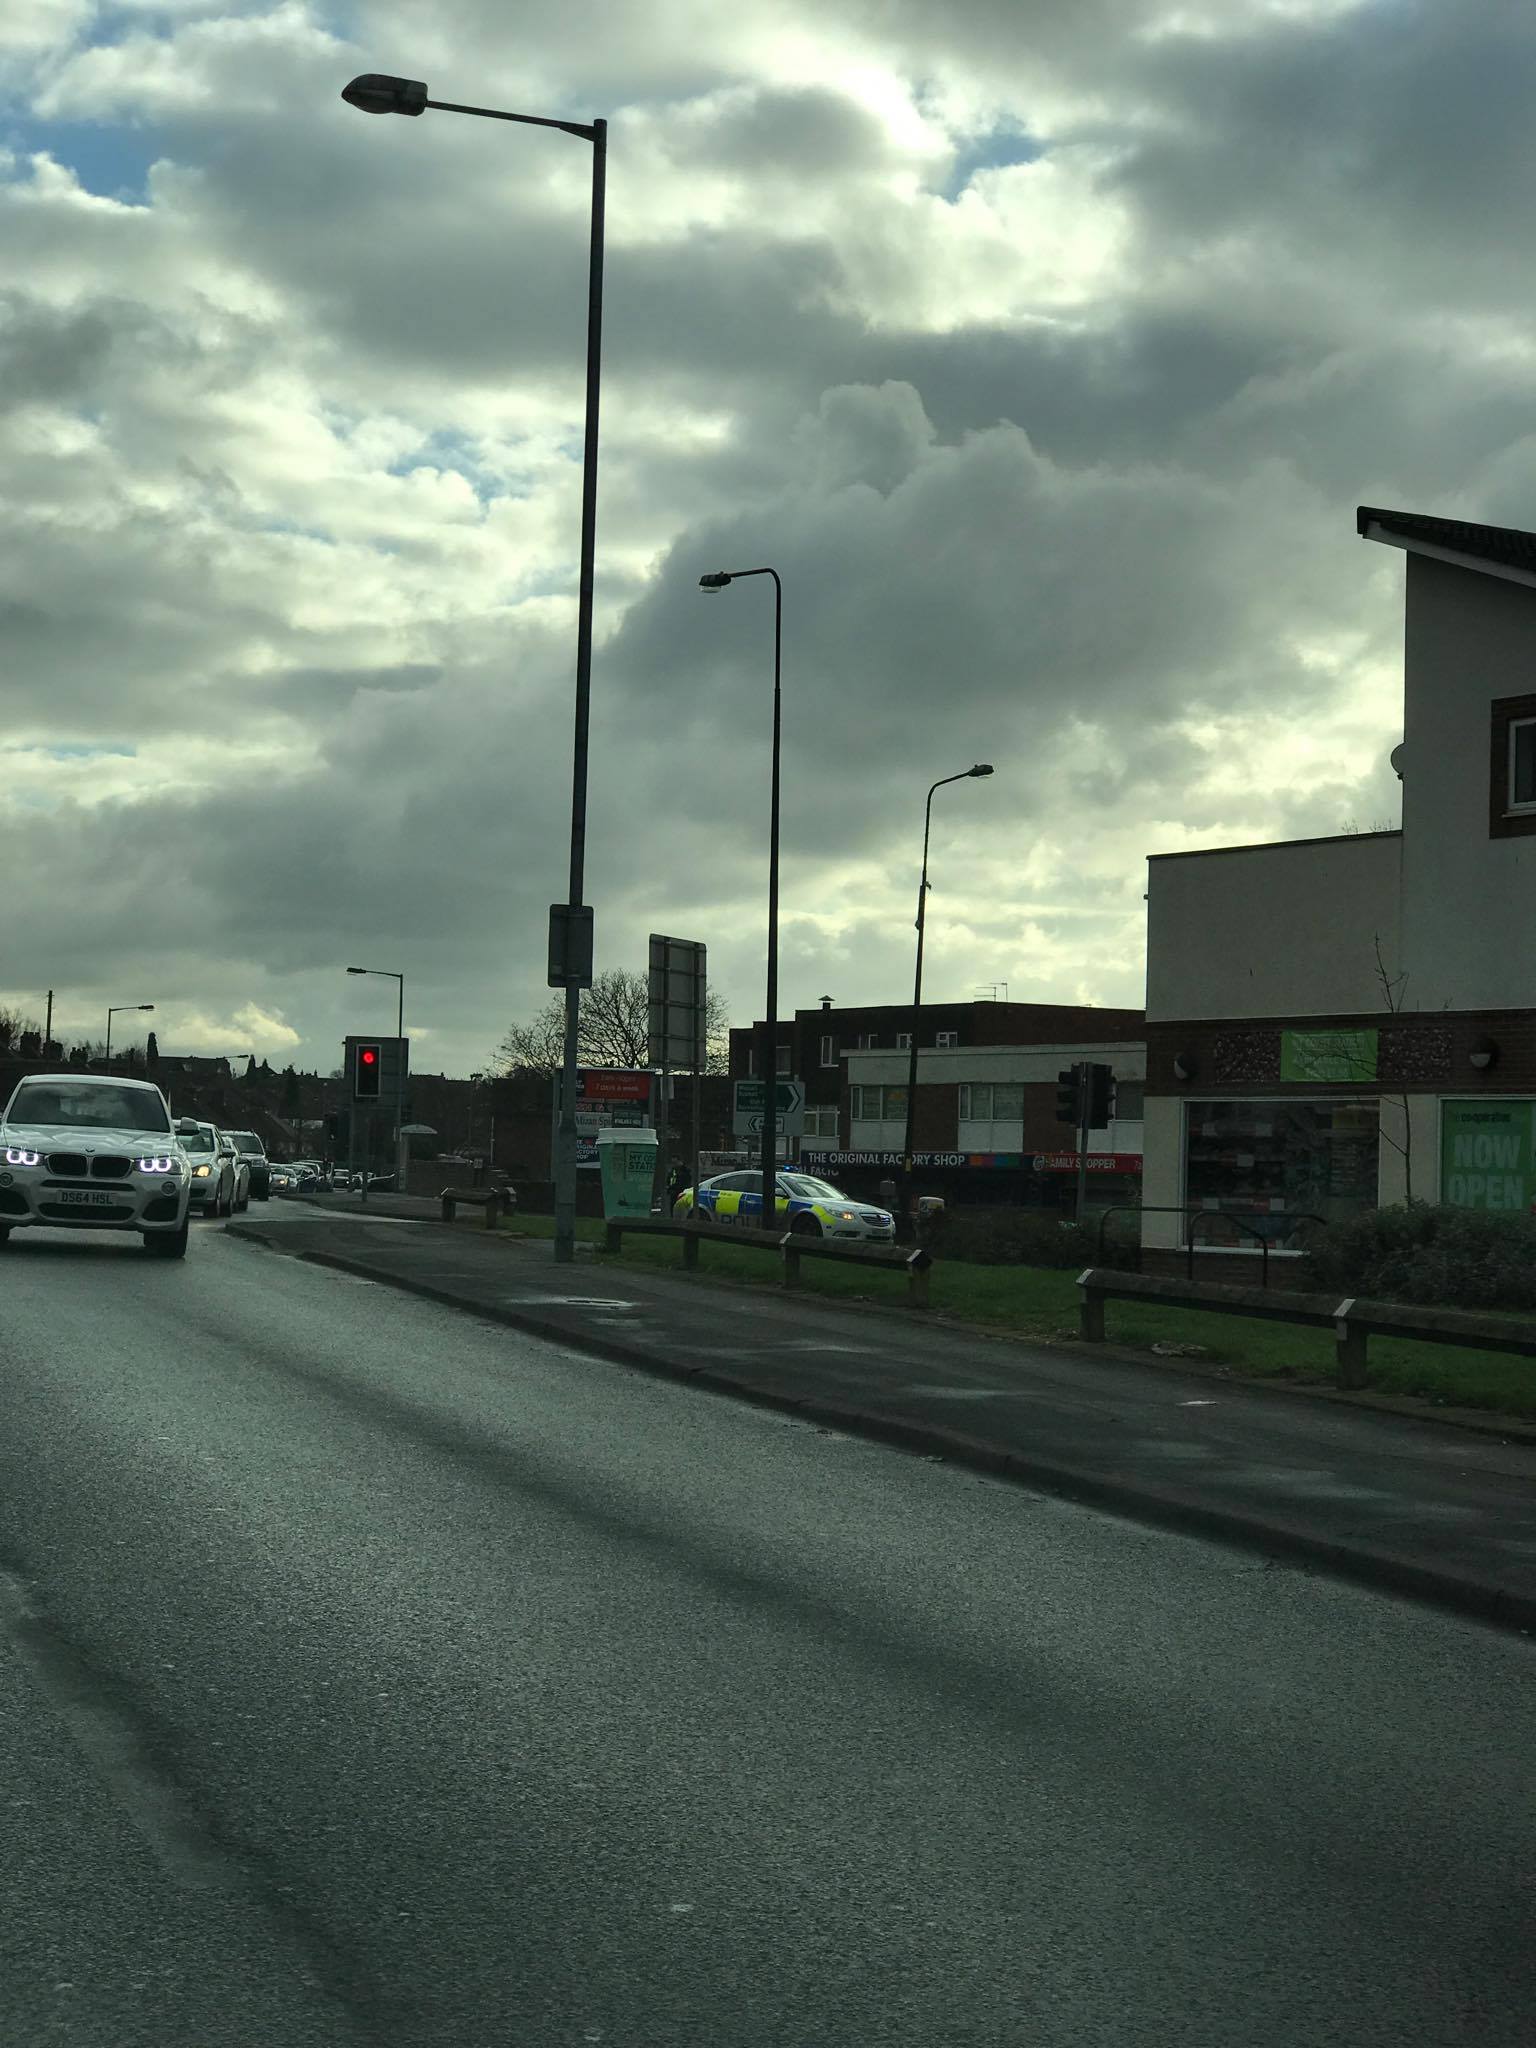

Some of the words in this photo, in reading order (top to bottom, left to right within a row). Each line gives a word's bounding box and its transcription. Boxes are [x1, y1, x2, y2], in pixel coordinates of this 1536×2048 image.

[1454, 1134, 1521, 1169] NOW
[808, 1152, 826, 1164] THE
[829, 1153, 880, 1165] ORIGINAL
[883, 1153, 930, 1166] FACORY
[933, 1155, 965, 1167] SHOP
[1075, 1158, 1116, 1169] SOPPER
[61, 1192, 90, 1203] DS64
[92, 1193, 113, 1204] HSL
[1448, 1174, 1523, 1210] OPEN
